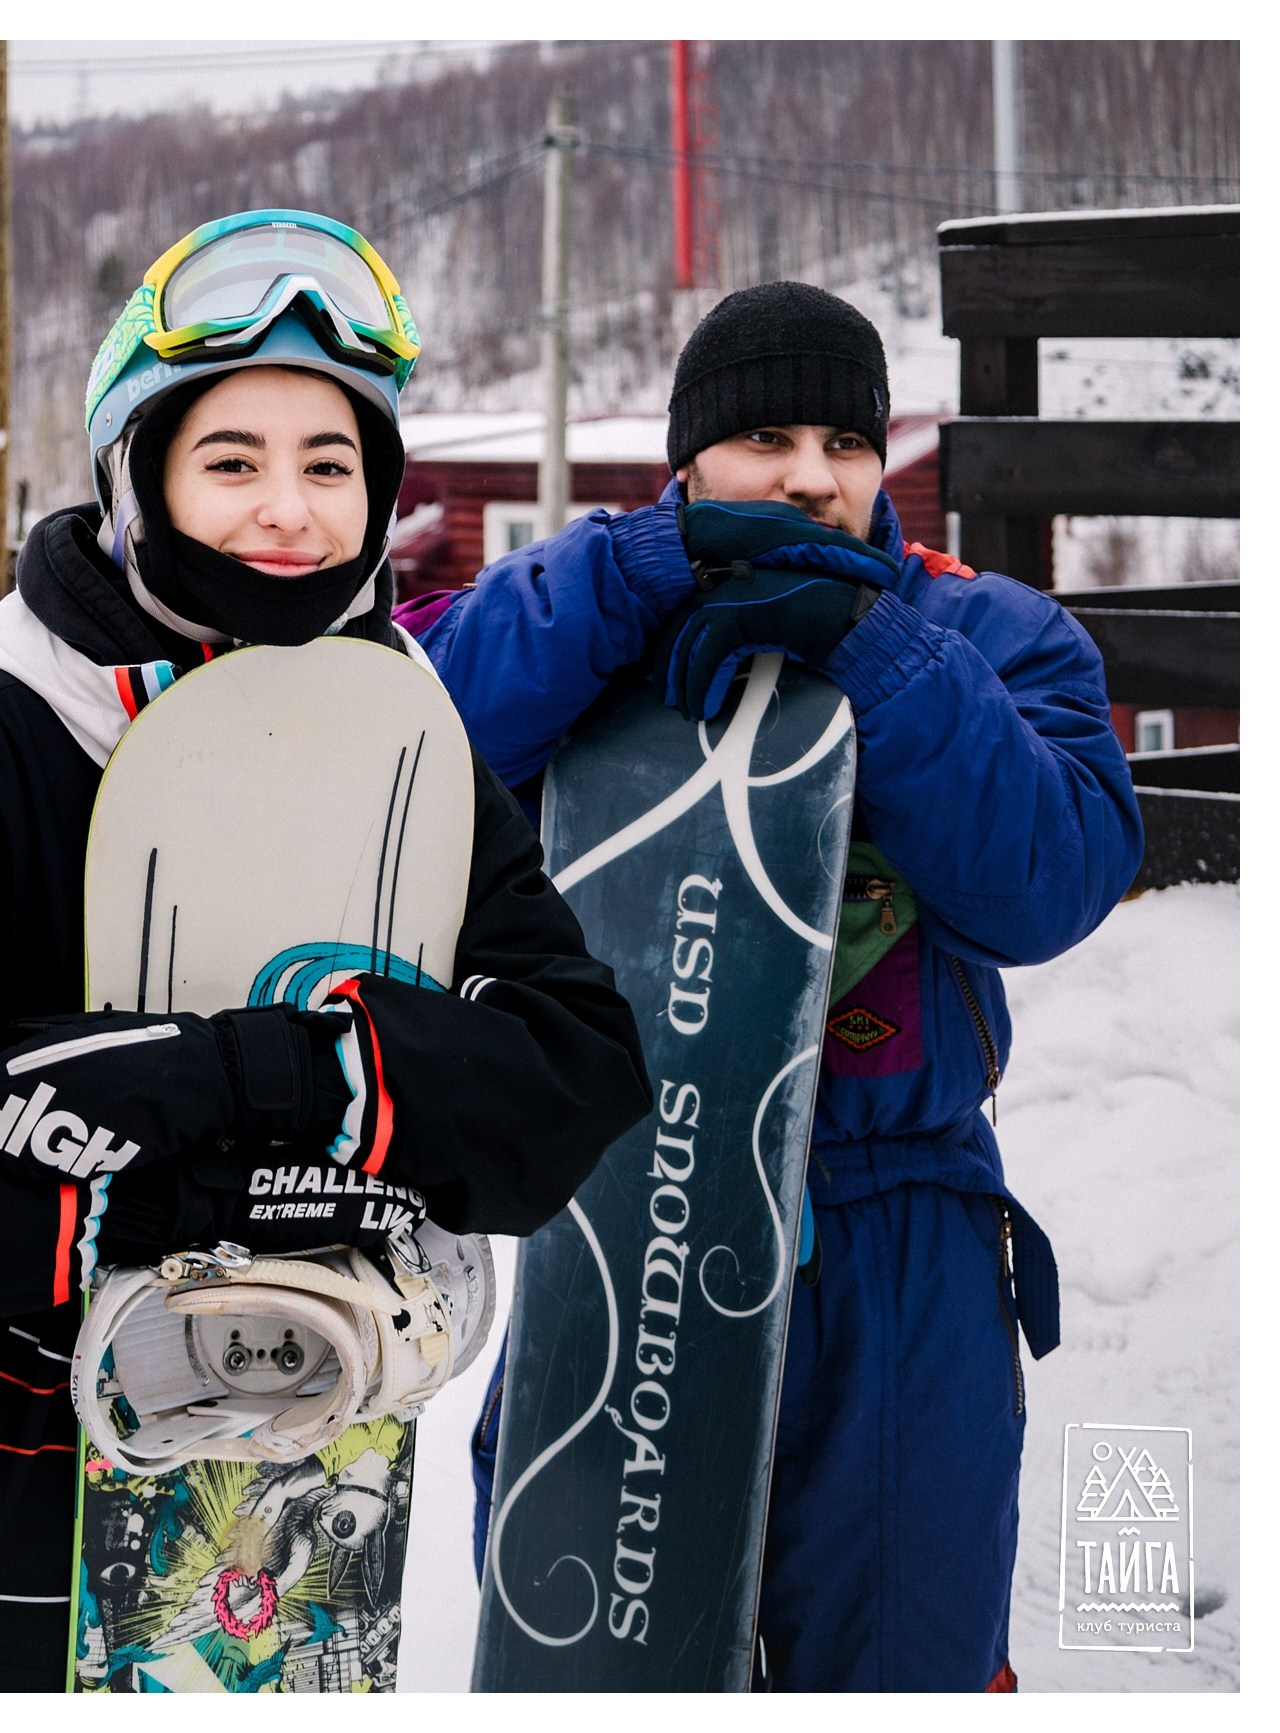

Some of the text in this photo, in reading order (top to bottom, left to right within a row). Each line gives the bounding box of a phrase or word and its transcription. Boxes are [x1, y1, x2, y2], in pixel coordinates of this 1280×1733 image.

[668, 873, 723, 1036] USD
[849, 1014, 869, 1026] SKI
[840, 1027, 878, 1044] COMPANY
[249, 1202, 336, 1219] EXTREME
[605, 1078, 701, 1646] SNOWBOARDS
